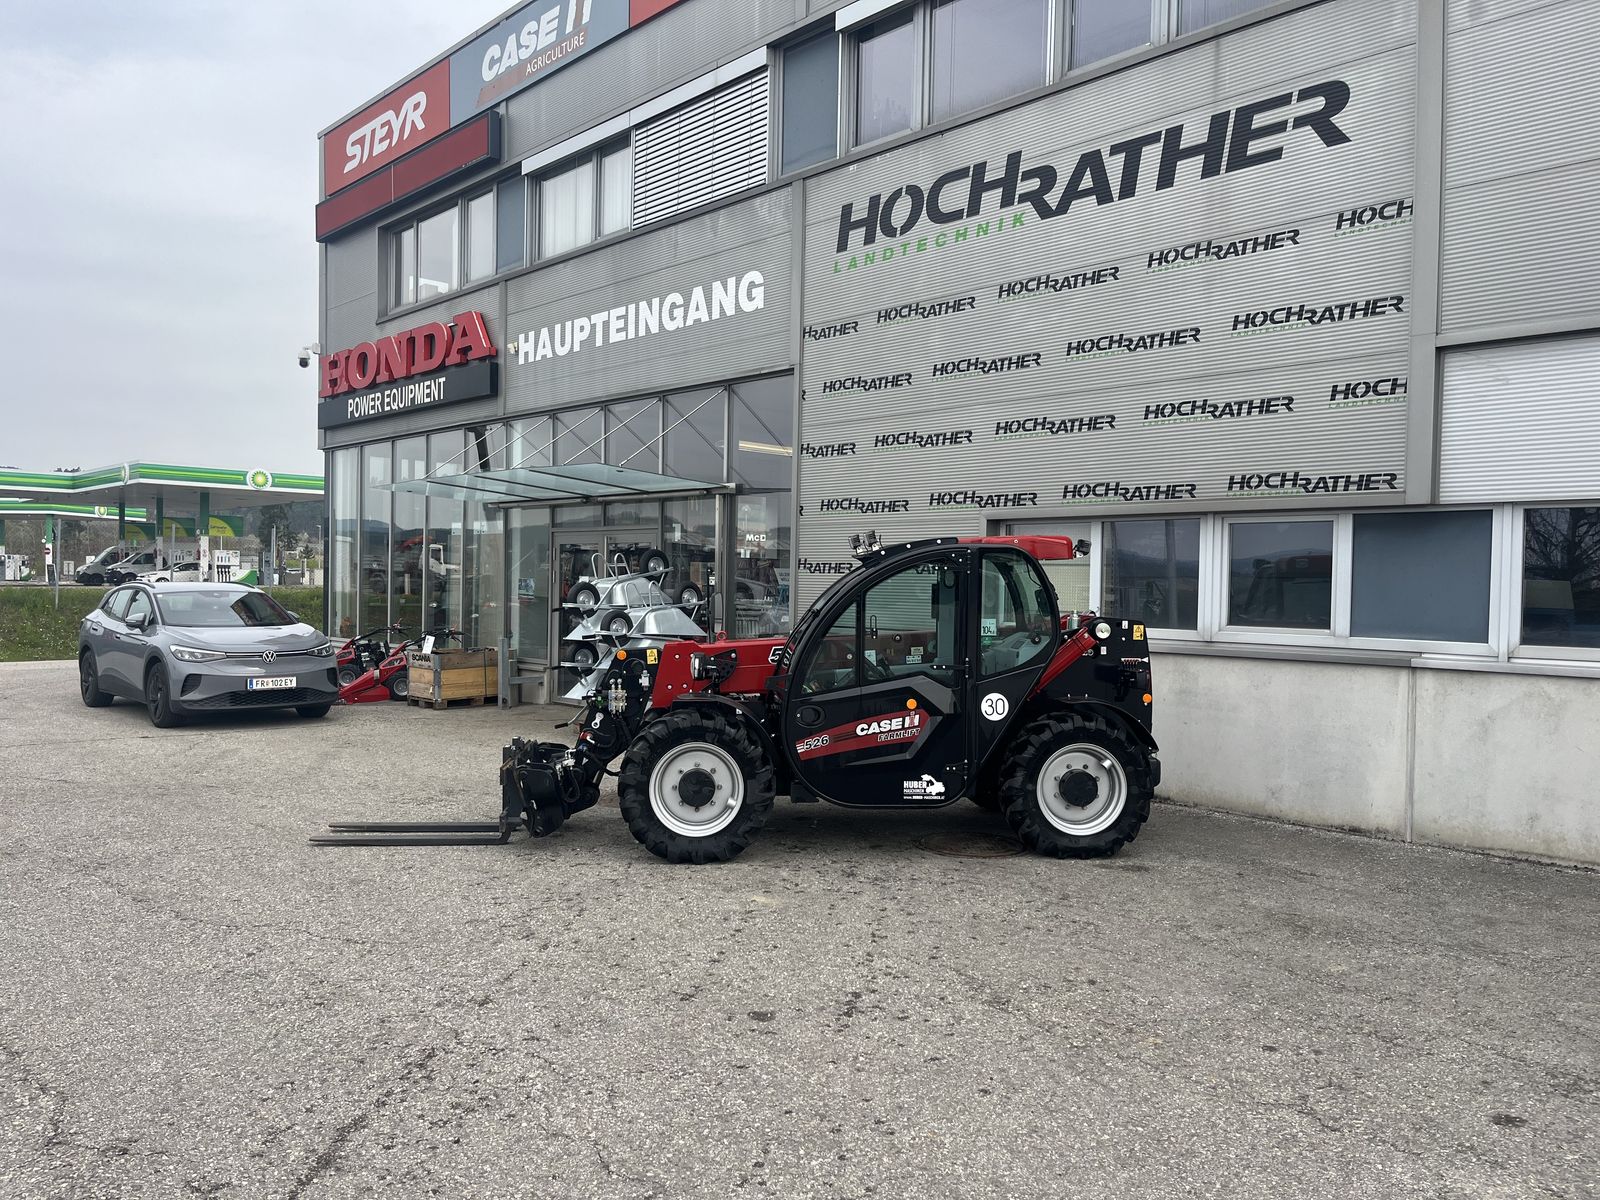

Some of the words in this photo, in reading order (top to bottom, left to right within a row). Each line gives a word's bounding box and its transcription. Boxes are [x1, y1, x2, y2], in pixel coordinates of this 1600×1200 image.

[481, 5, 561, 82] CASE
[525, 31, 585, 76] AGRICULTURE
[344, 91, 427, 174] STEYR
[836, 80, 1352, 254] HOCHRATHER
[1335, 200, 1414, 230] HOCH
[833, 211, 1026, 273] LANDTECHNIK
[1147, 229, 1300, 268] HOCHRATHER
[998, 266, 1120, 299] HOCHRATHER
[518, 270, 765, 365] HAUPTEINGANG
[876, 296, 976, 324] HOCHRATHER
[1231, 295, 1405, 331] HOCHRATHER
[319, 311, 496, 398] HONDA
[1066, 327, 1201, 357] HOCHRATHER
[932, 352, 1042, 377] HOCHRATHER
[823, 372, 913, 392] HOCHRATHER
[1329, 377, 1408, 402] HOCH
[348, 391, 382, 419] POWER
[384, 377, 446, 412] EQUIPMENT
[1143, 395, 1295, 420] HOCHRATHER
[995, 414, 1116, 435] HOCHRATHER
[874, 430, 973, 448] HOCHRATHER
[1062, 481, 1197, 502] HOCHRATHER
[1227, 471, 1398, 494] HOCHRATHER
[820, 497, 910, 514] HOCHRATHER
[929, 490, 1038, 509] HOCHRATHER
[411, 653, 431, 663] SCANIA
[255, 679, 265, 688] FR
[984, 698, 1005, 716] 30
[855, 718, 903, 736] CASE
[878, 728, 920, 742] FARMLIFT
[803, 735, 830, 751] 526
[903, 780, 927, 789] HUBER
